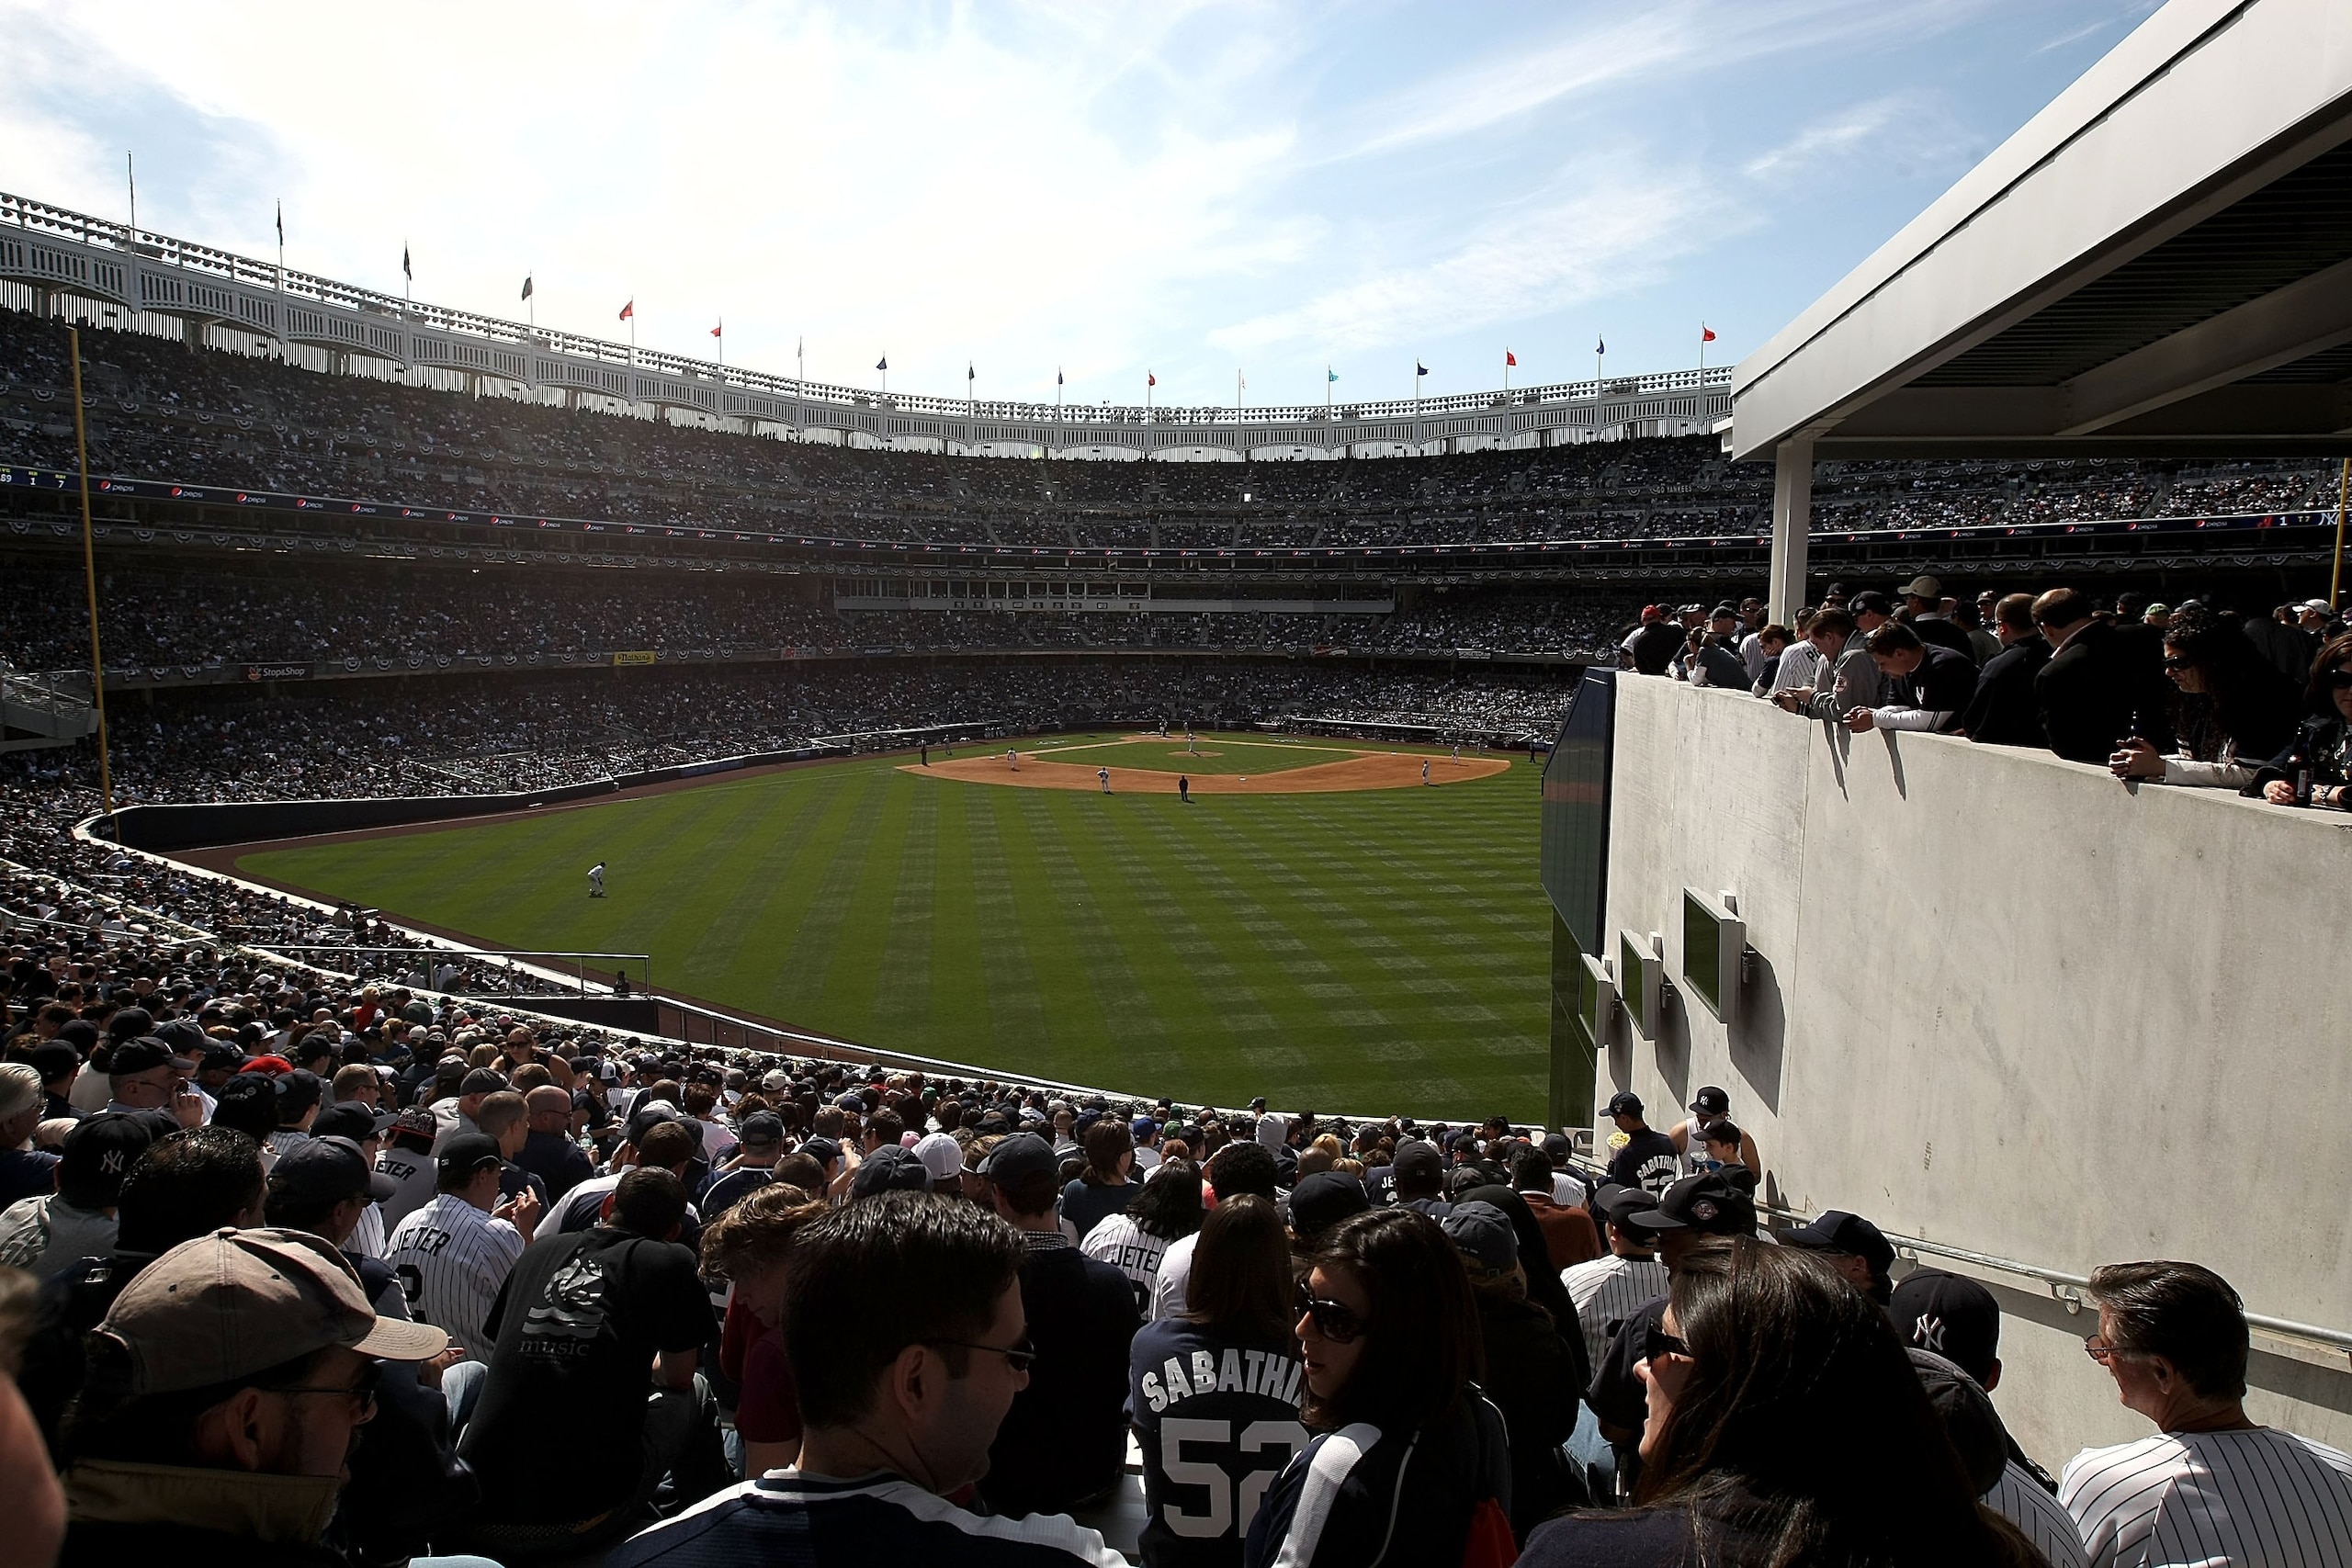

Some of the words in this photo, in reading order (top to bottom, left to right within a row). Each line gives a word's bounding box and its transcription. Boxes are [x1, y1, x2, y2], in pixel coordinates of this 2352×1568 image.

[112, 484, 134, 492] pepsi
[183, 490, 203, 498] pepsi
[1667, 485, 1692, 494] YANKEES
[2279, 516, 2289, 526] 1
[393, 1227, 450, 1257] JETER
[1113, 1245, 1164, 1273] JETE
[517, 1337, 590, 1358] music
[1141, 1348, 1302, 1413] SABATHI
